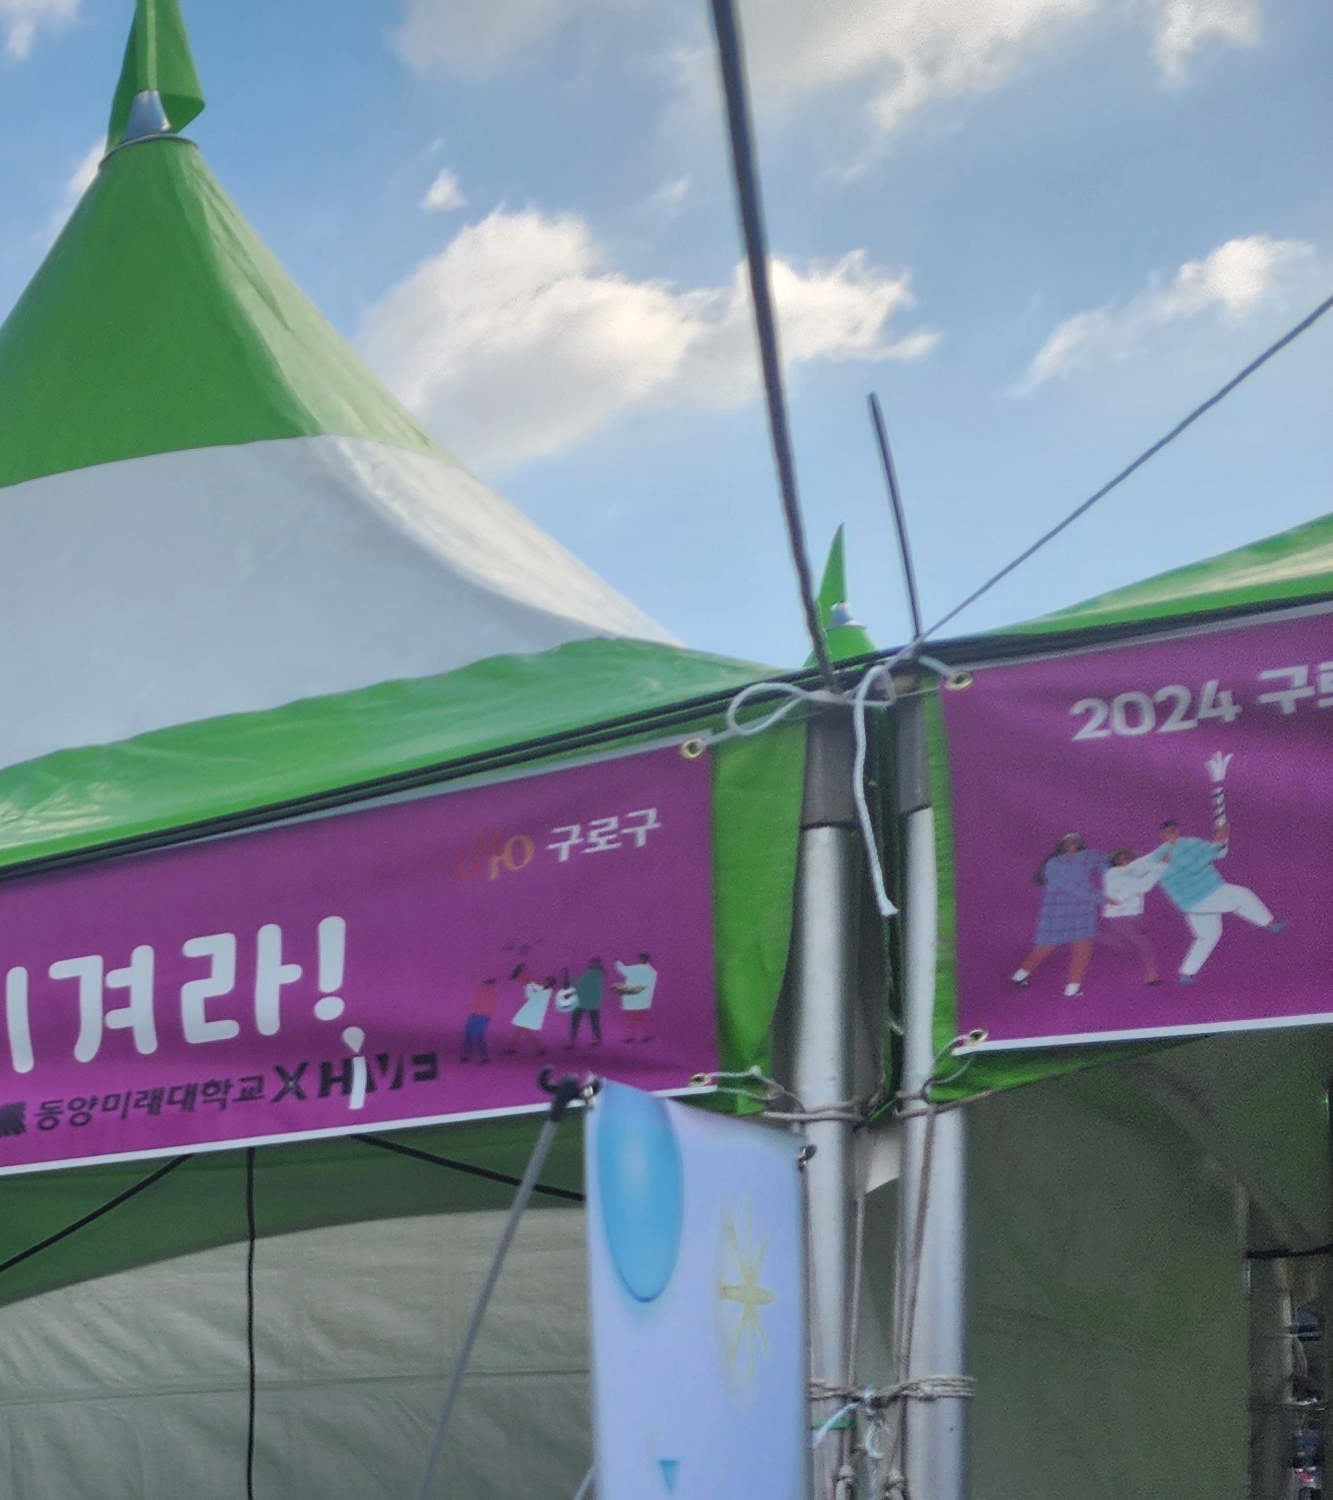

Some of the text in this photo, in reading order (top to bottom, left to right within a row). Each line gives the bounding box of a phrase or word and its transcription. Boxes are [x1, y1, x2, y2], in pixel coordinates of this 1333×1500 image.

[1069, 660, 1333, 741] 2024 구
[545, 808, 661, 863] 구로구
[36, 1076, 265, 1131] 동양미래대학교
